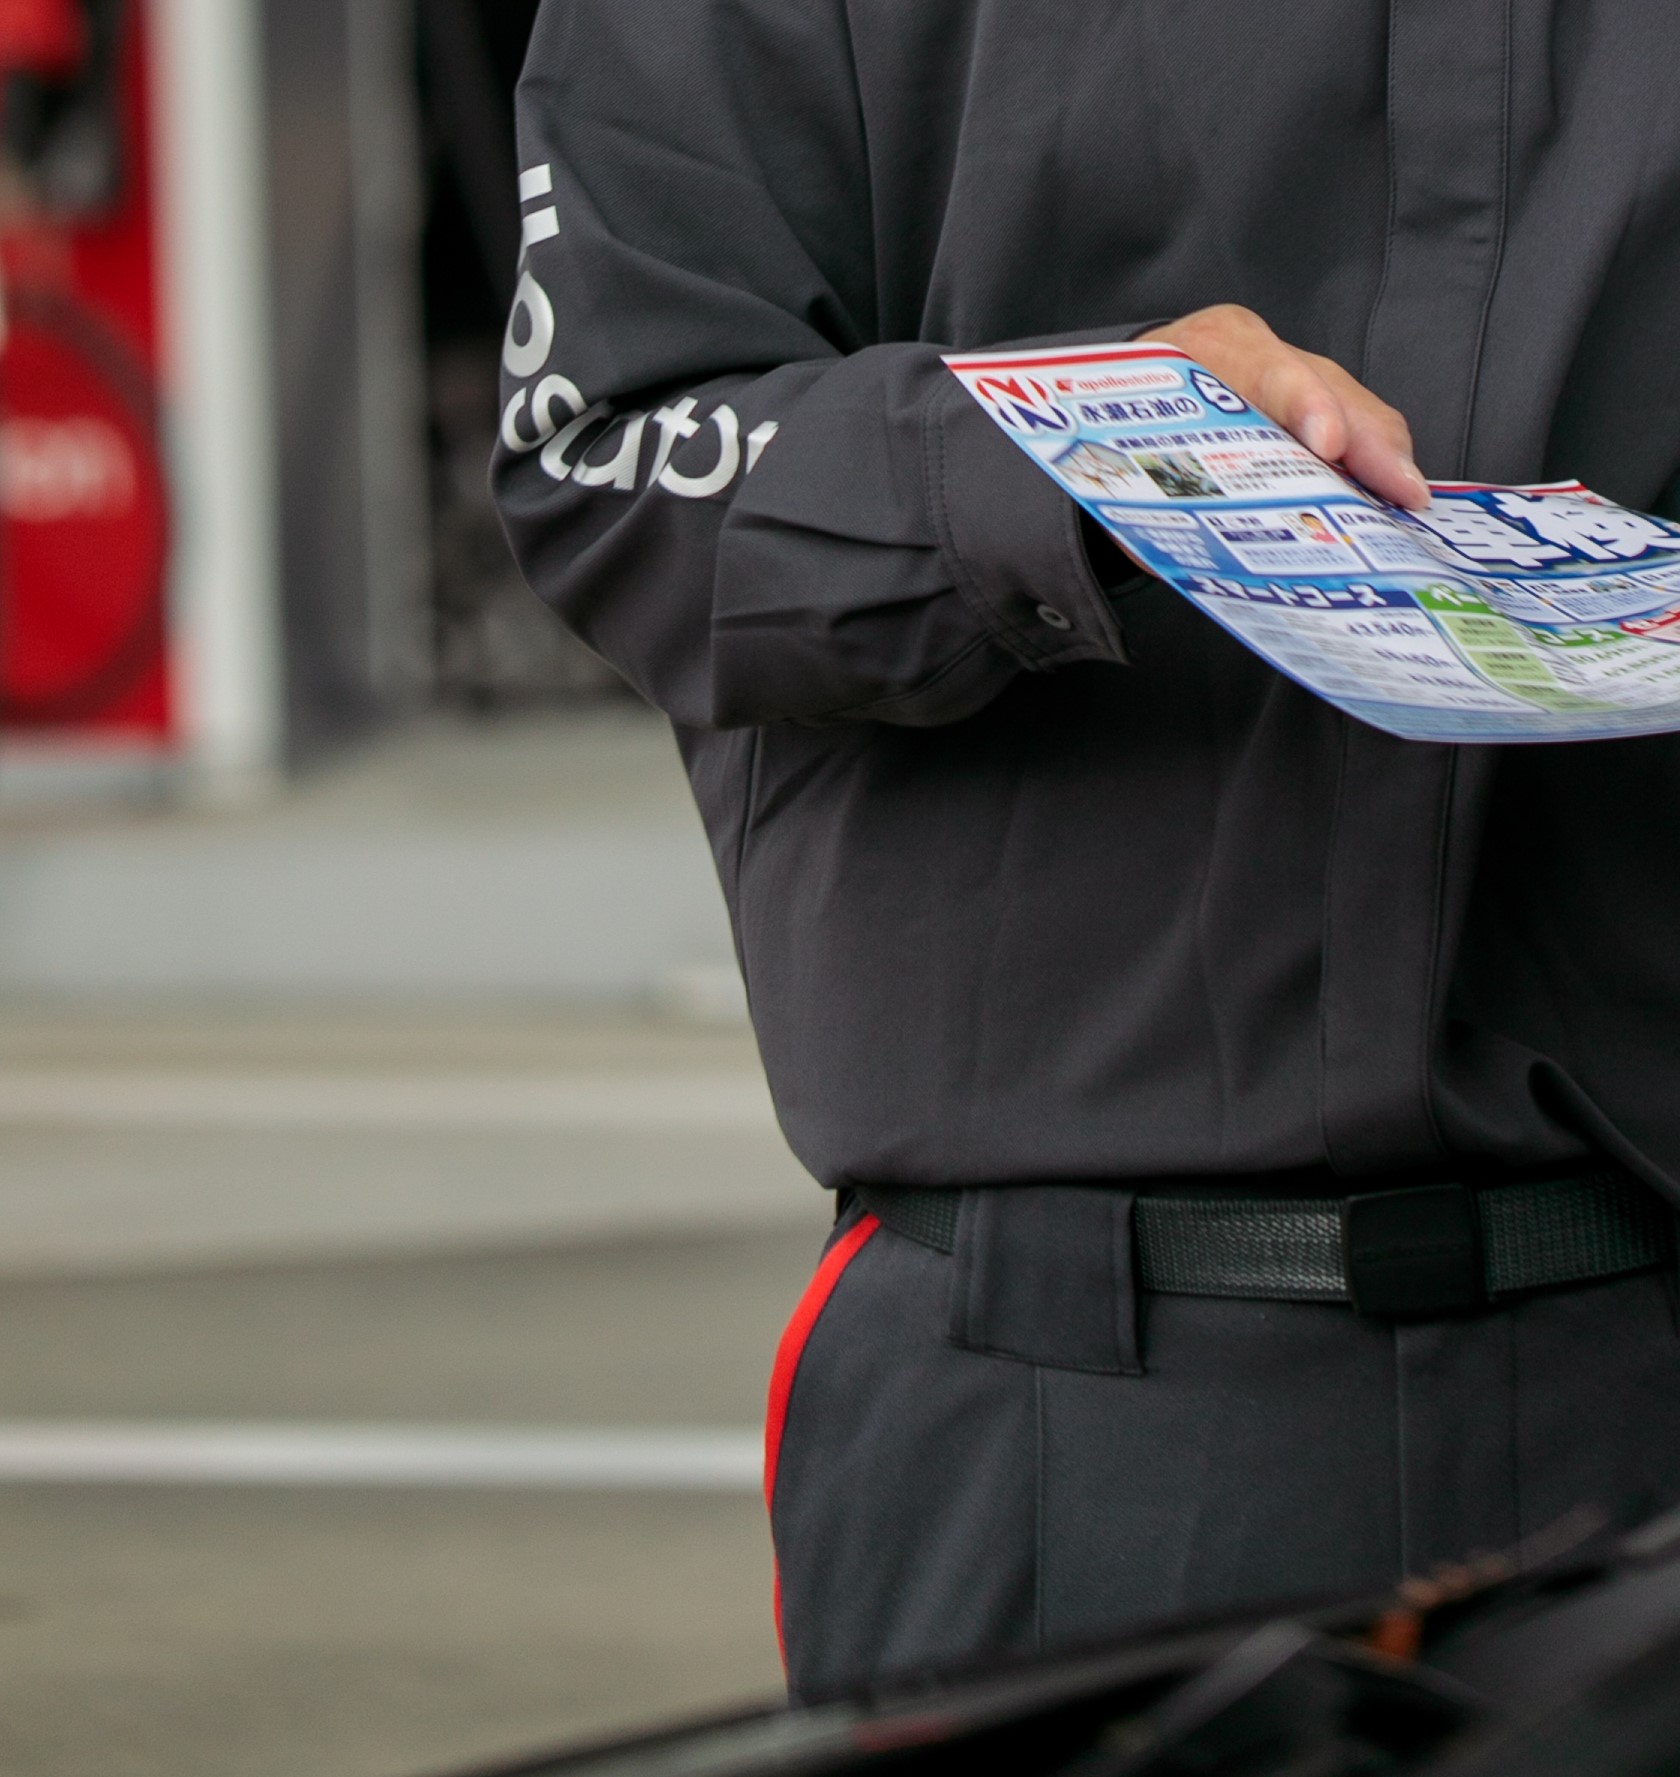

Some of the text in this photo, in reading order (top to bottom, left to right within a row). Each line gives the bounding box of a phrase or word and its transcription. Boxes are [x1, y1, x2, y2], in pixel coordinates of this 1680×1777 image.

[1077, 371, 1178, 393] apollostation
[1188, 574, 1388, 608] スマートコース
